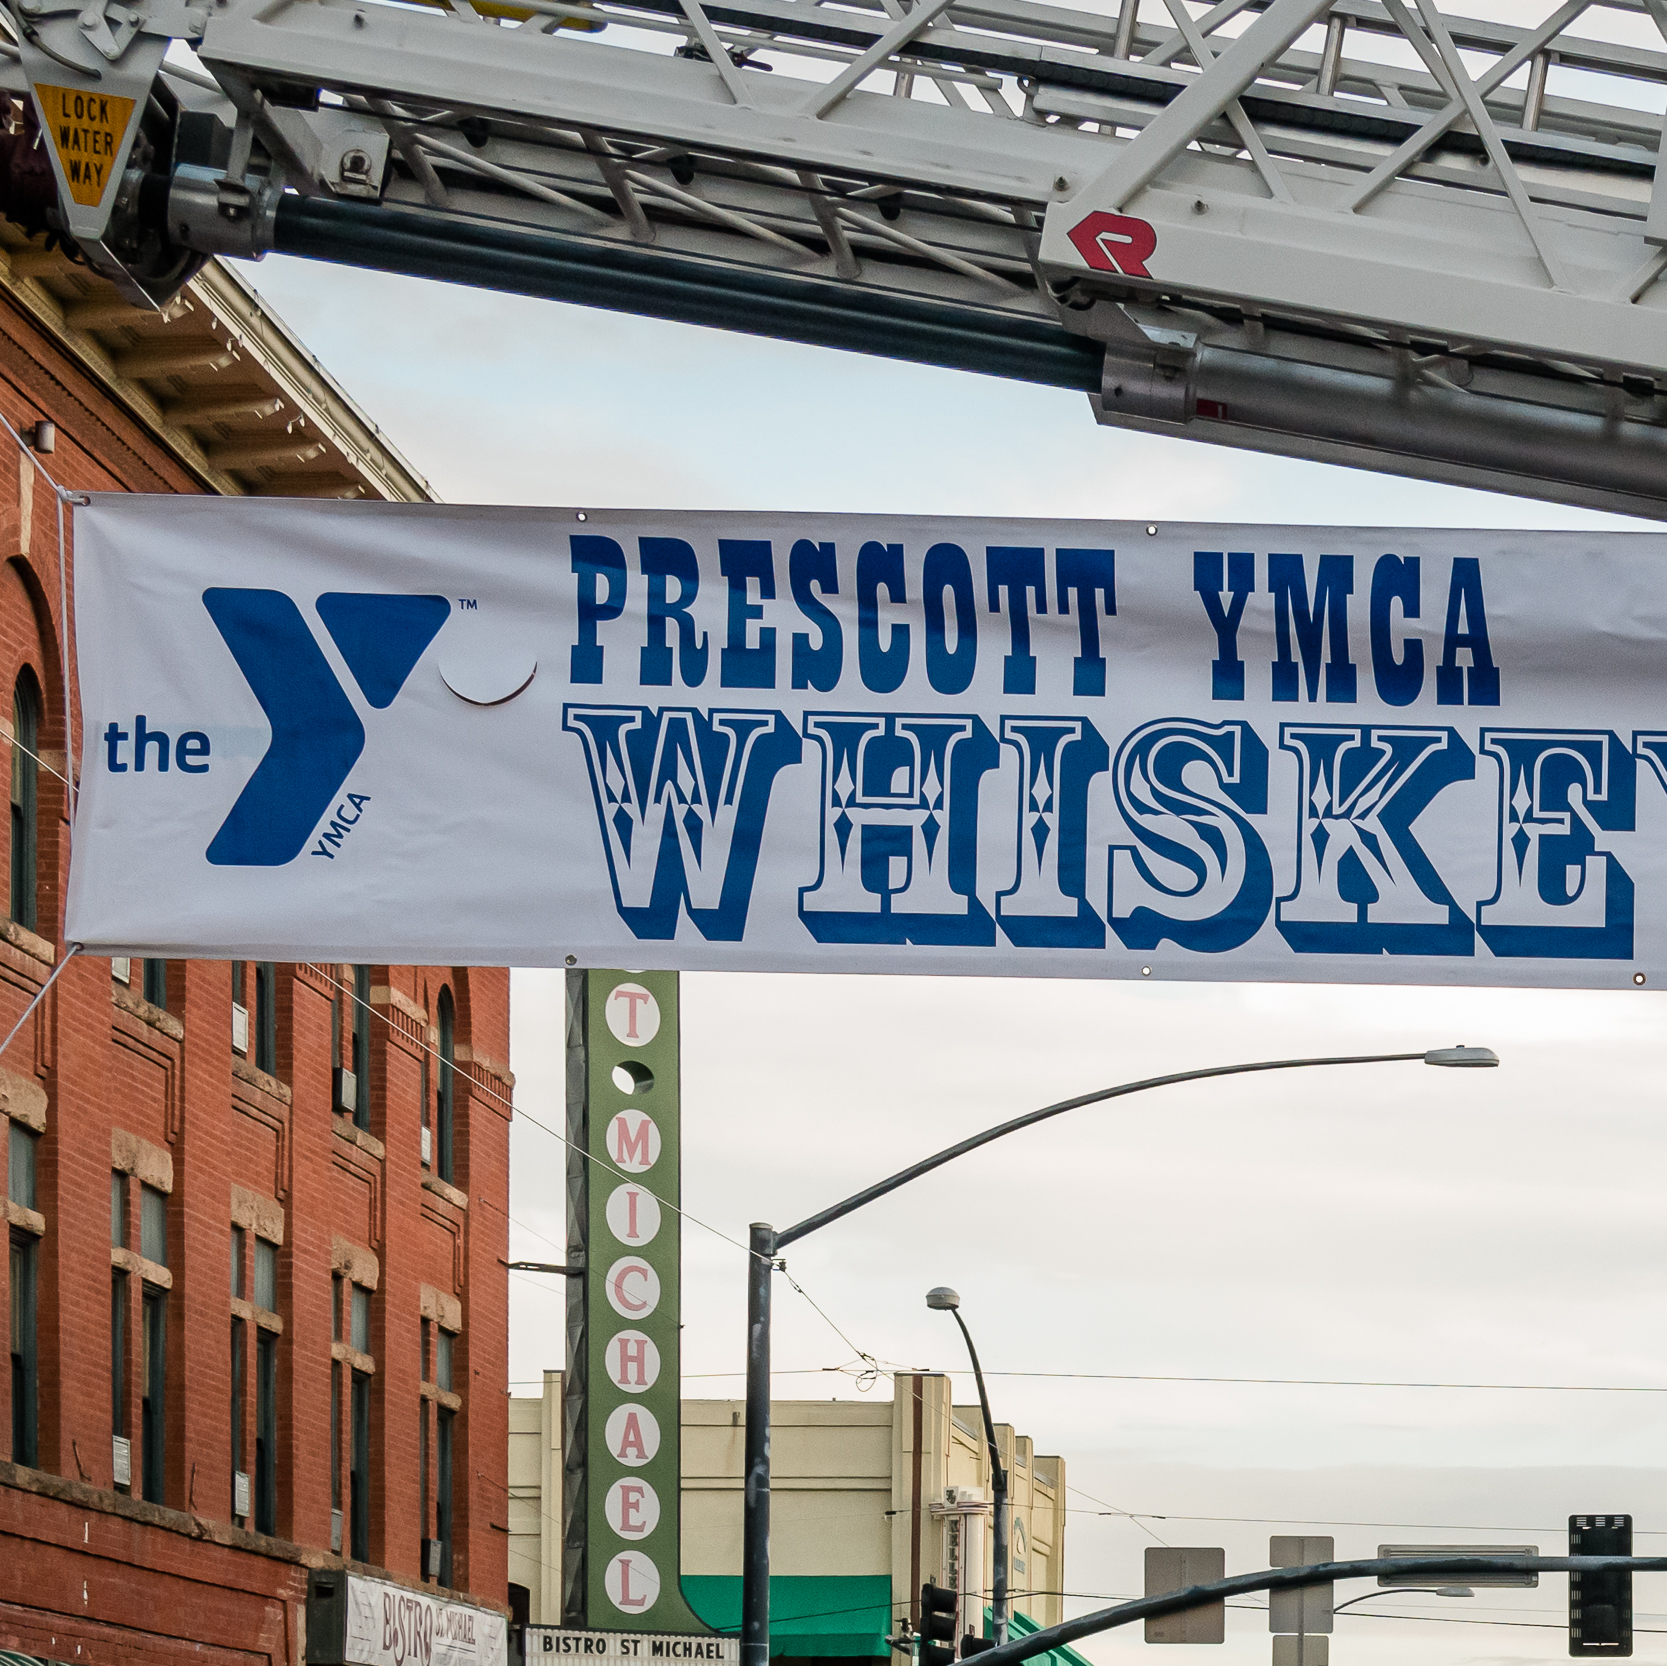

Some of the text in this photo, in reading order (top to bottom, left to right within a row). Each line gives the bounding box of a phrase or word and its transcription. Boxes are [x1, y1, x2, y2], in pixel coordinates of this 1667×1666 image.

[61, 93, 111, 120] LOCK
[58, 125, 114, 157] WATER
[69, 161, 105, 189] WAY
[569, 533, 1502, 708] PRESCOTT YMCA
[104, 714, 211, 774] the
[311, 791, 371, 861] YMCA
[614, 1116, 652, 1608] MICHAEL
[543, 1635, 724, 1660] BISTRO ST MICHAEL
